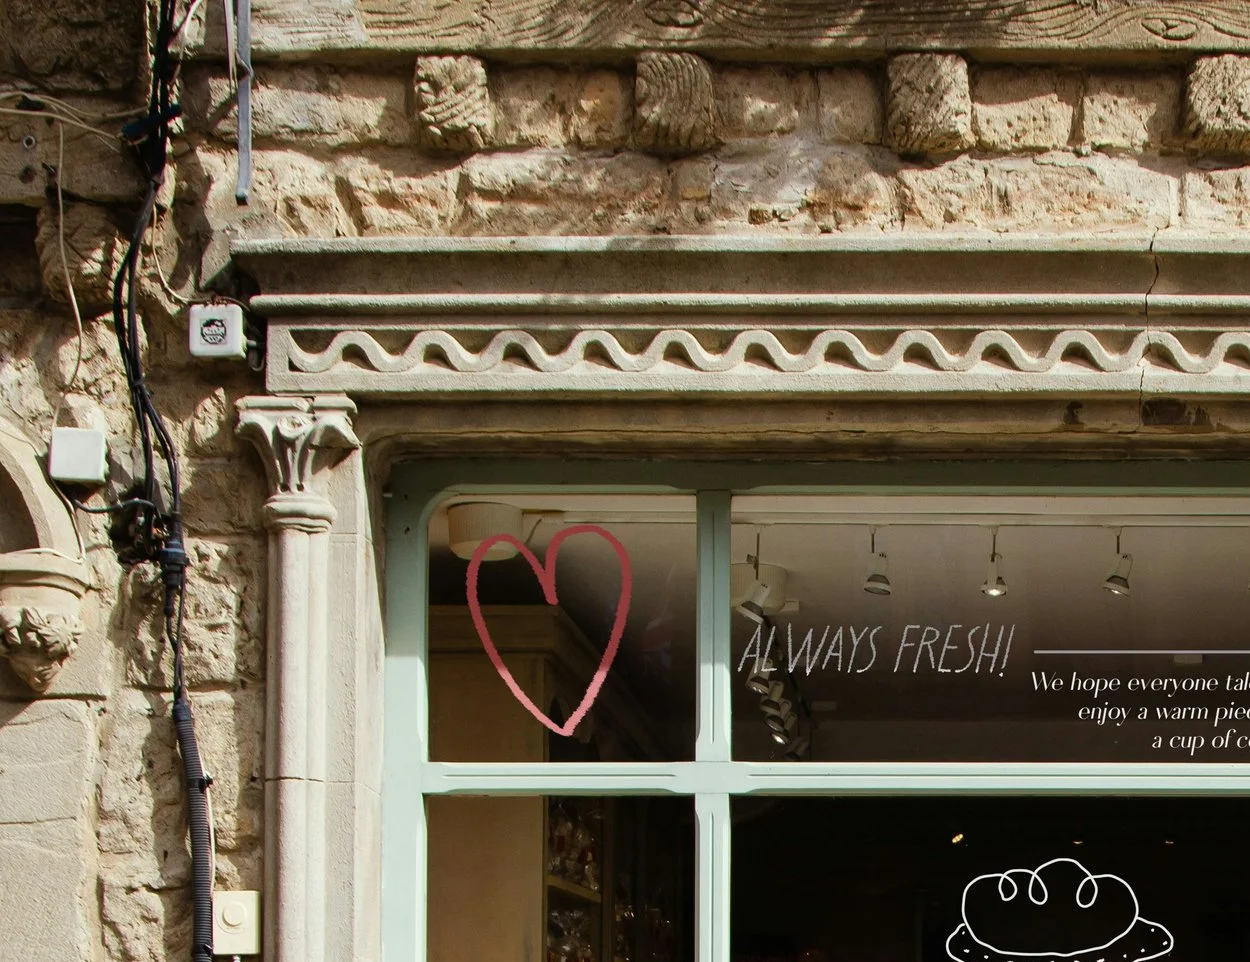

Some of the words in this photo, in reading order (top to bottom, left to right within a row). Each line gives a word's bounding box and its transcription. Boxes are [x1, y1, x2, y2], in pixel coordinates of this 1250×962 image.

[738, 622, 882, 677] ALWAYS
[894, 623, 1016, 677] FRESH!
[1031, 671, 1064, 692] We
[1070, 671, 1121, 698] hope
[1127, 677, 1219, 698] everyone
[1077, 701, 1131, 727] enjoy
[1137, 706, 1148, 720] a
[1155, 706, 1209, 720] warm
[1151, 735, 1163, 749] a
[1168, 735, 1205, 756] cup
[1211, 728, 1237, 749] of
